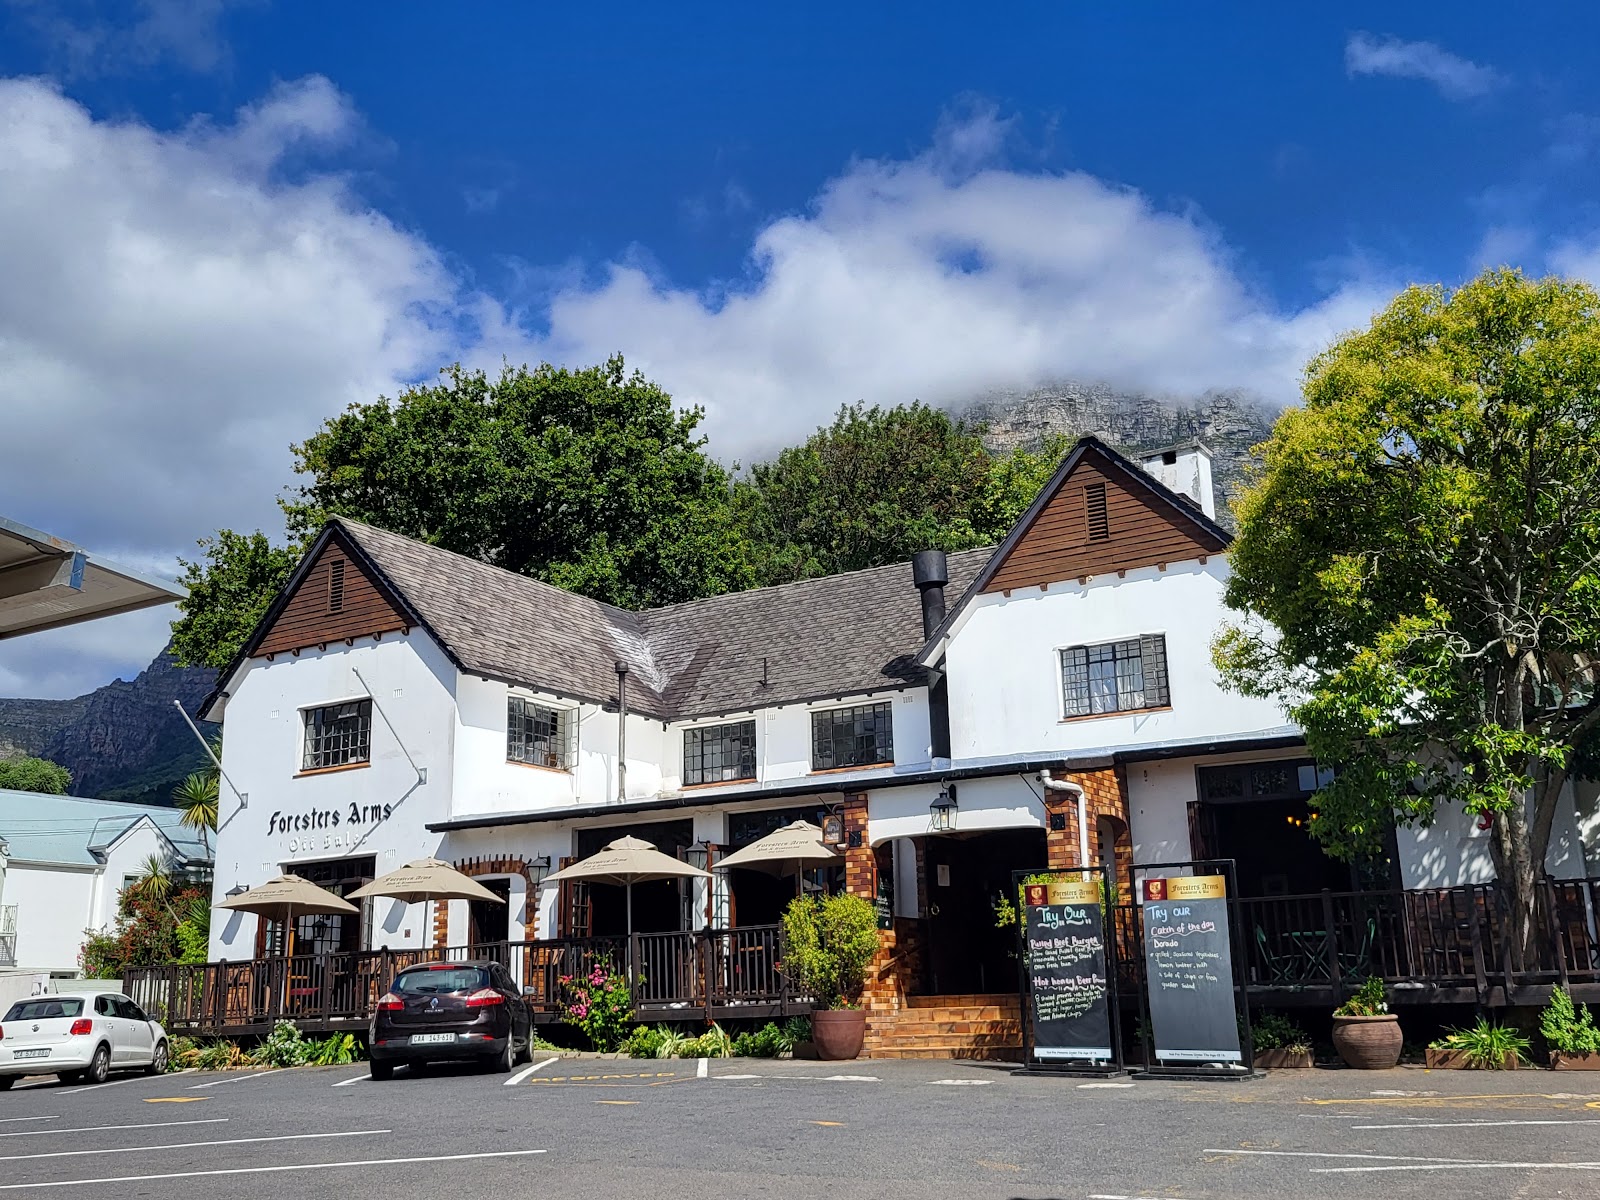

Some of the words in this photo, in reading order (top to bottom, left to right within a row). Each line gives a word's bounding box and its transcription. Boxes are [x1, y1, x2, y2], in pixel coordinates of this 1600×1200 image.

[267, 807, 341, 836] Foresters
[347, 802, 392, 825] Arms
[1171, 884, 1200, 893] Foresters
[1202, 882, 1219, 890] Arms
[1151, 925, 1175, 936] Catch
[1176, 922, 1185, 933] of
[1187, 922, 1201, 931] the
[1201, 920, 1215, 931] day
[1153, 938, 1179, 948] Dorado
[1032, 975, 1049, 987] Hot
[429, 1033, 453, 1042] 143-618
